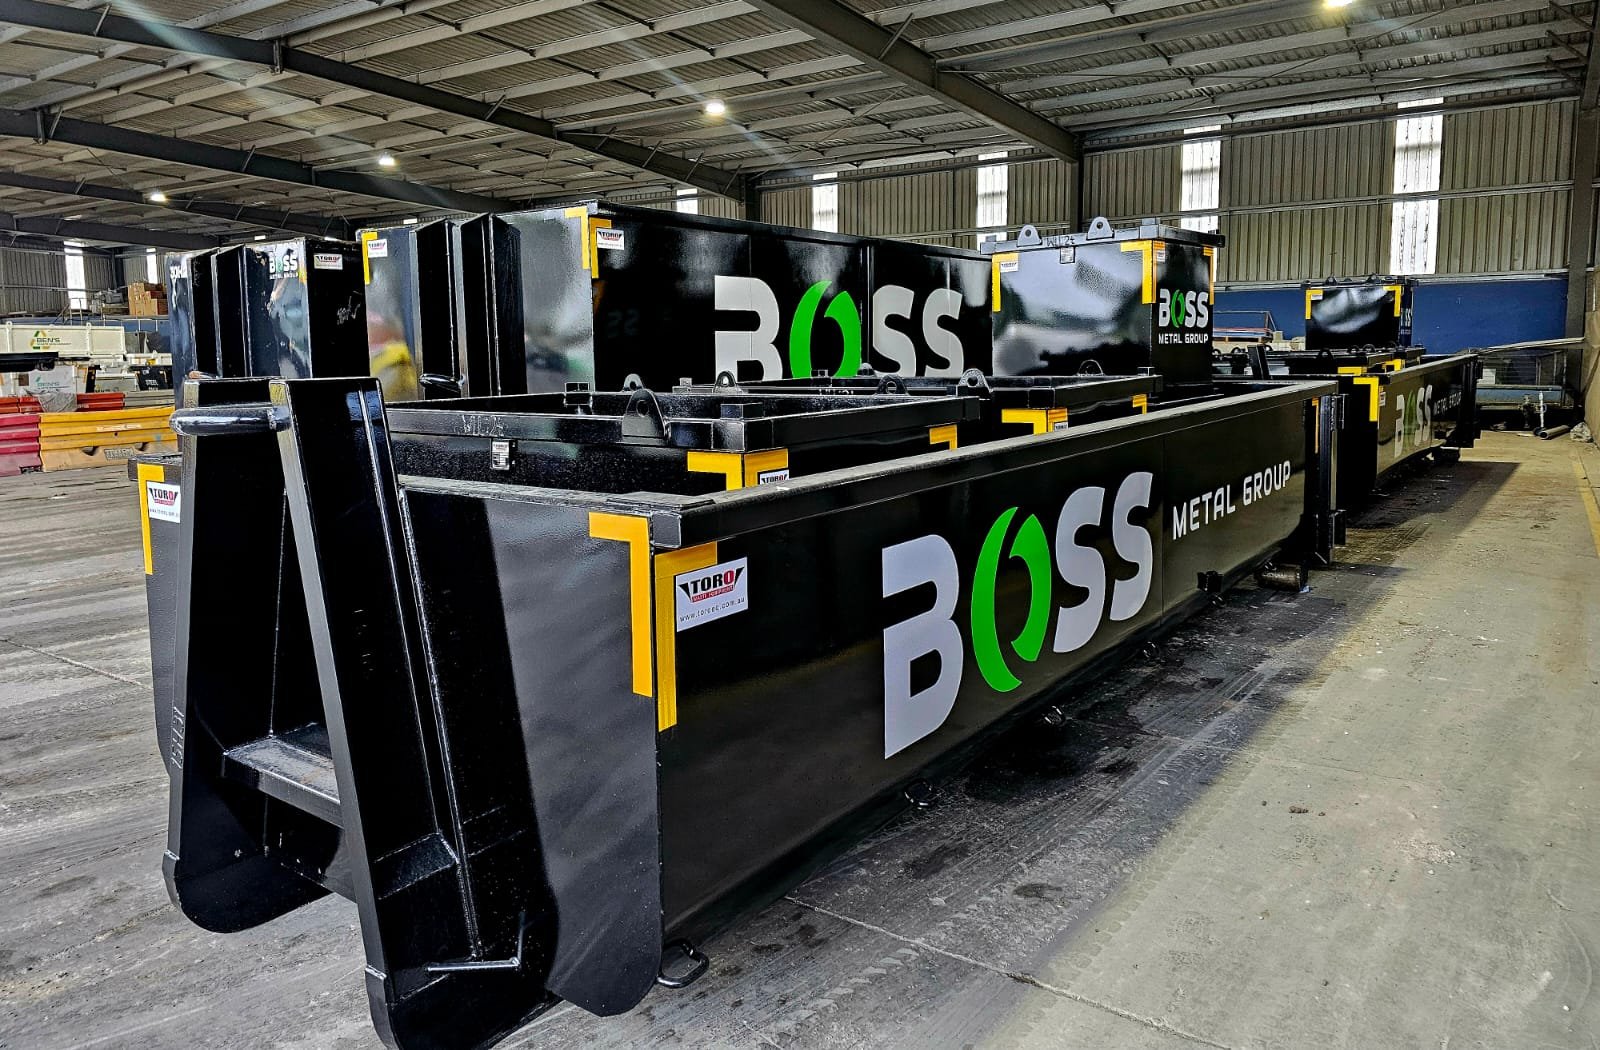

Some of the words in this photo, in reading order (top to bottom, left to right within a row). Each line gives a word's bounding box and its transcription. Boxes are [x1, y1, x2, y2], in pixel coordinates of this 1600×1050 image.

[269, 251, 298, 273] BOSS
[714, 275, 964, 380] BOSS
[1158, 288, 1209, 328] BOSS
[1158, 333, 1183, 344] METAL
[1185, 332, 1209, 343] GROUP
[1394, 384, 1433, 458] BOSS
[153, 488, 174, 501] TORO
[1172, 488, 1236, 540] METAL
[1242, 460, 1291, 507] GROUP
[690, 570, 735, 594] TORO
[882, 472, 1153, 759] BOSS
